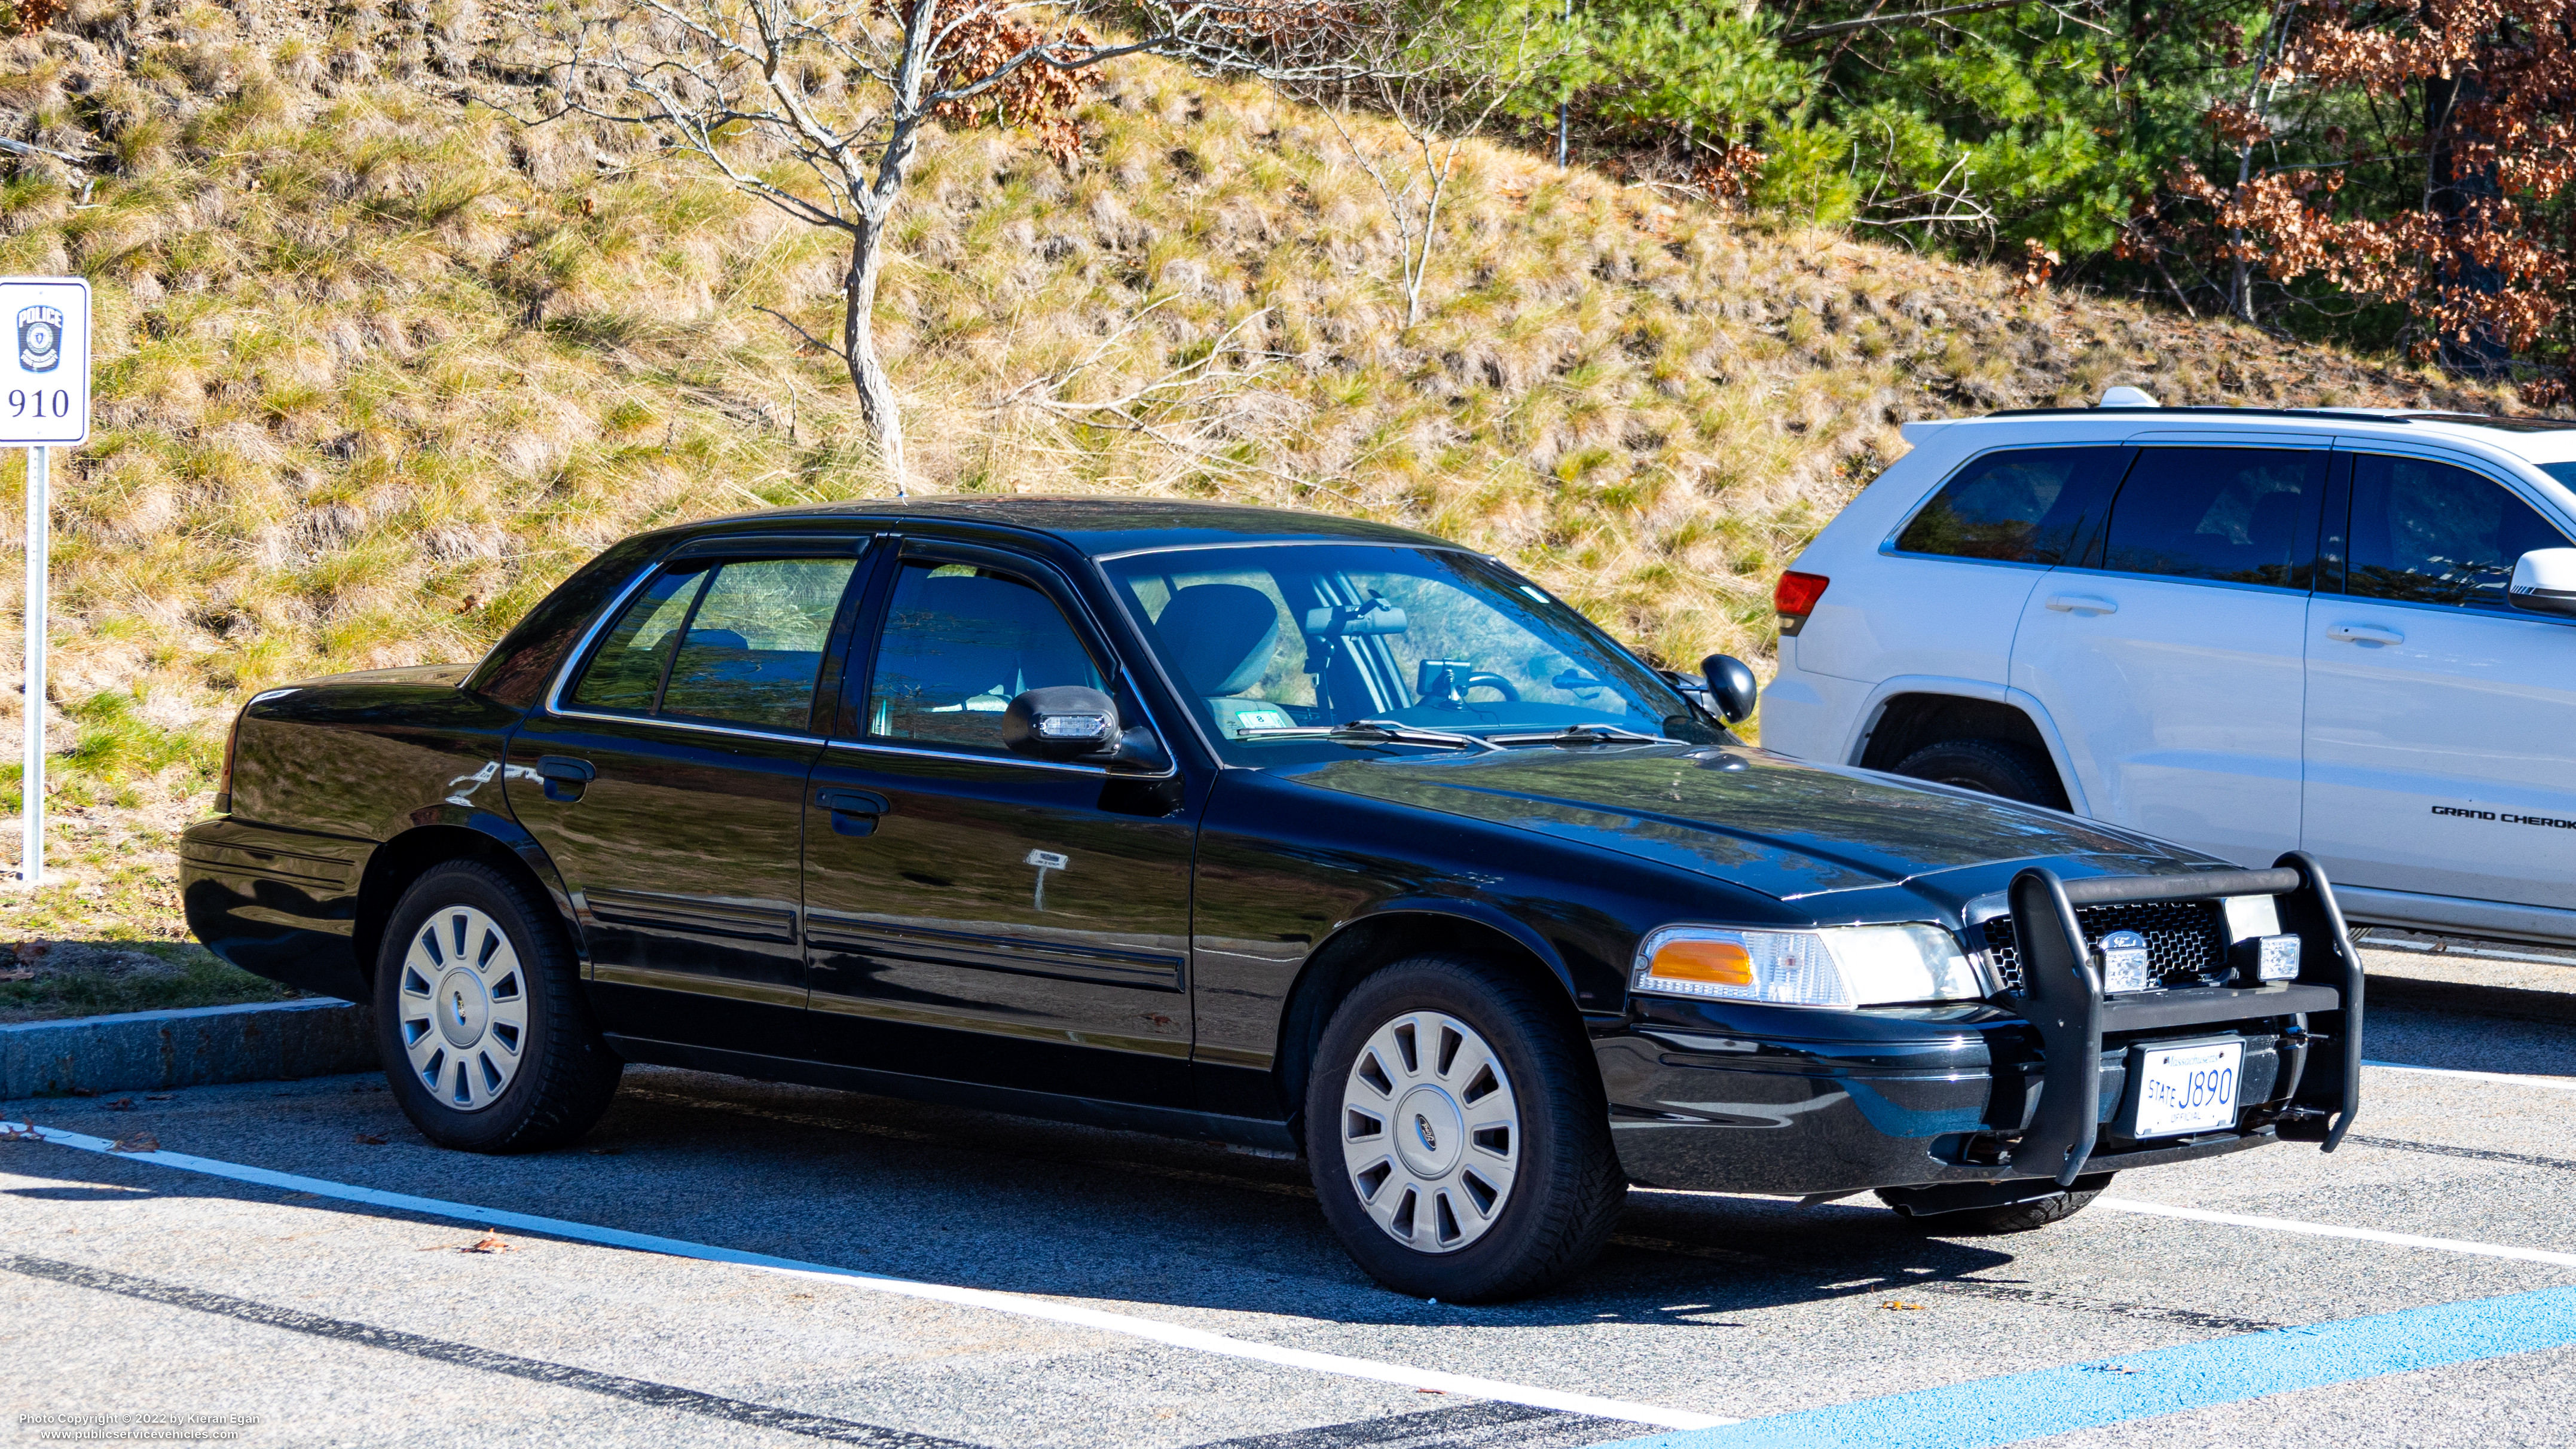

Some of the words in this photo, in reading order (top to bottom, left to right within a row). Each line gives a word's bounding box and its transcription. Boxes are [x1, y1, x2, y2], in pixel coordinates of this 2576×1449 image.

[19, 307, 62, 328] POLICE
[8, 390, 69, 417] 910
[2431, 806, 2496, 821] GRAND
[2149, 1079, 2176, 1108] STATE
[2178, 1068, 2232, 1109] J890
[2171, 1112, 2201, 1123] OFFICIAL
